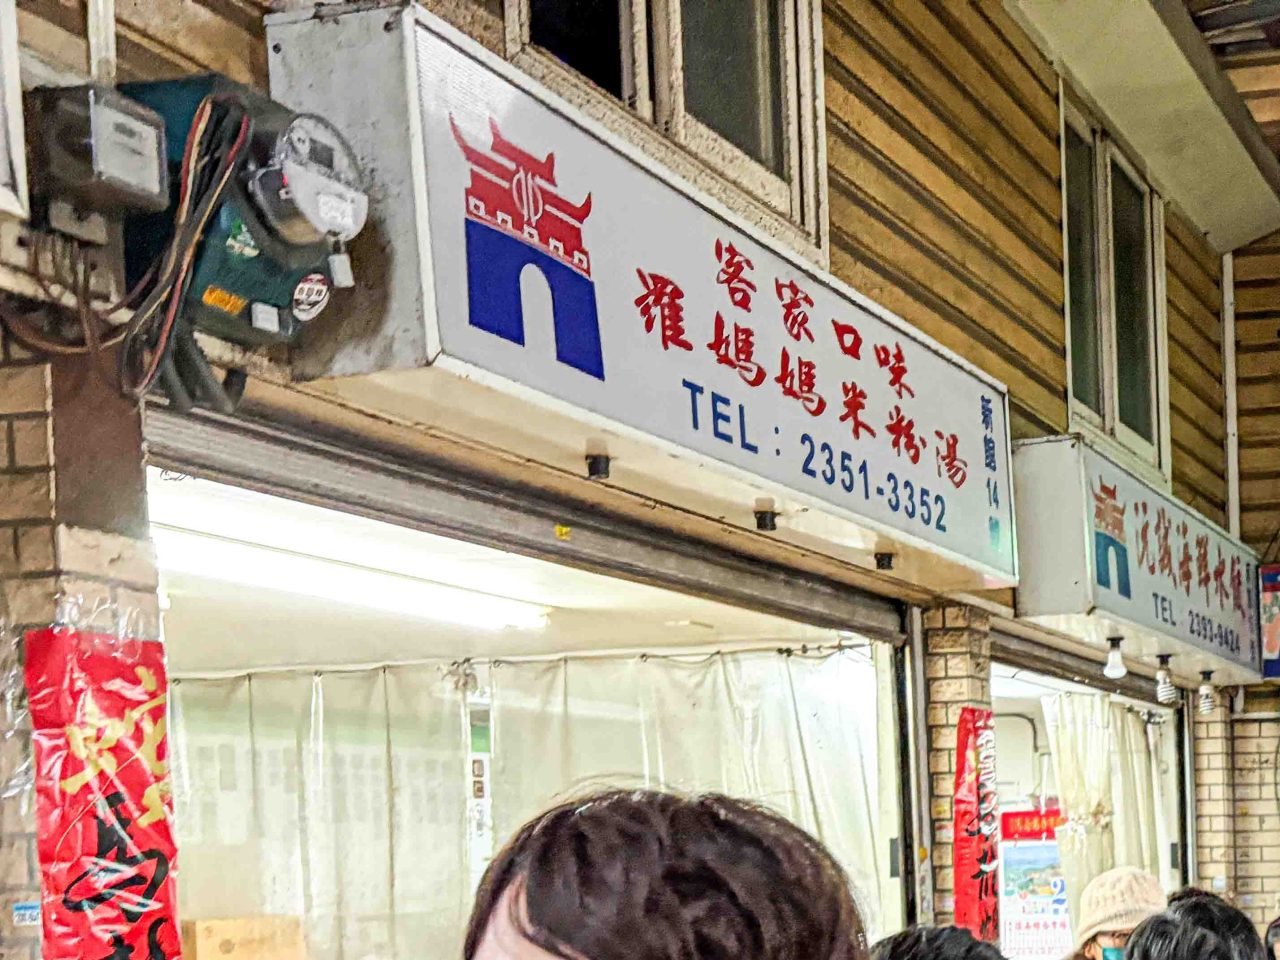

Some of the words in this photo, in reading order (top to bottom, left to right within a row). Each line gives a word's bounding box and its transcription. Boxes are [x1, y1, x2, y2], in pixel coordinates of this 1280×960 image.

[634, 268, 968, 489] 羅媽媽米粉湯
[715, 238, 914, 398] 客家口味
[800, 433, 947, 533] 2351-3352
